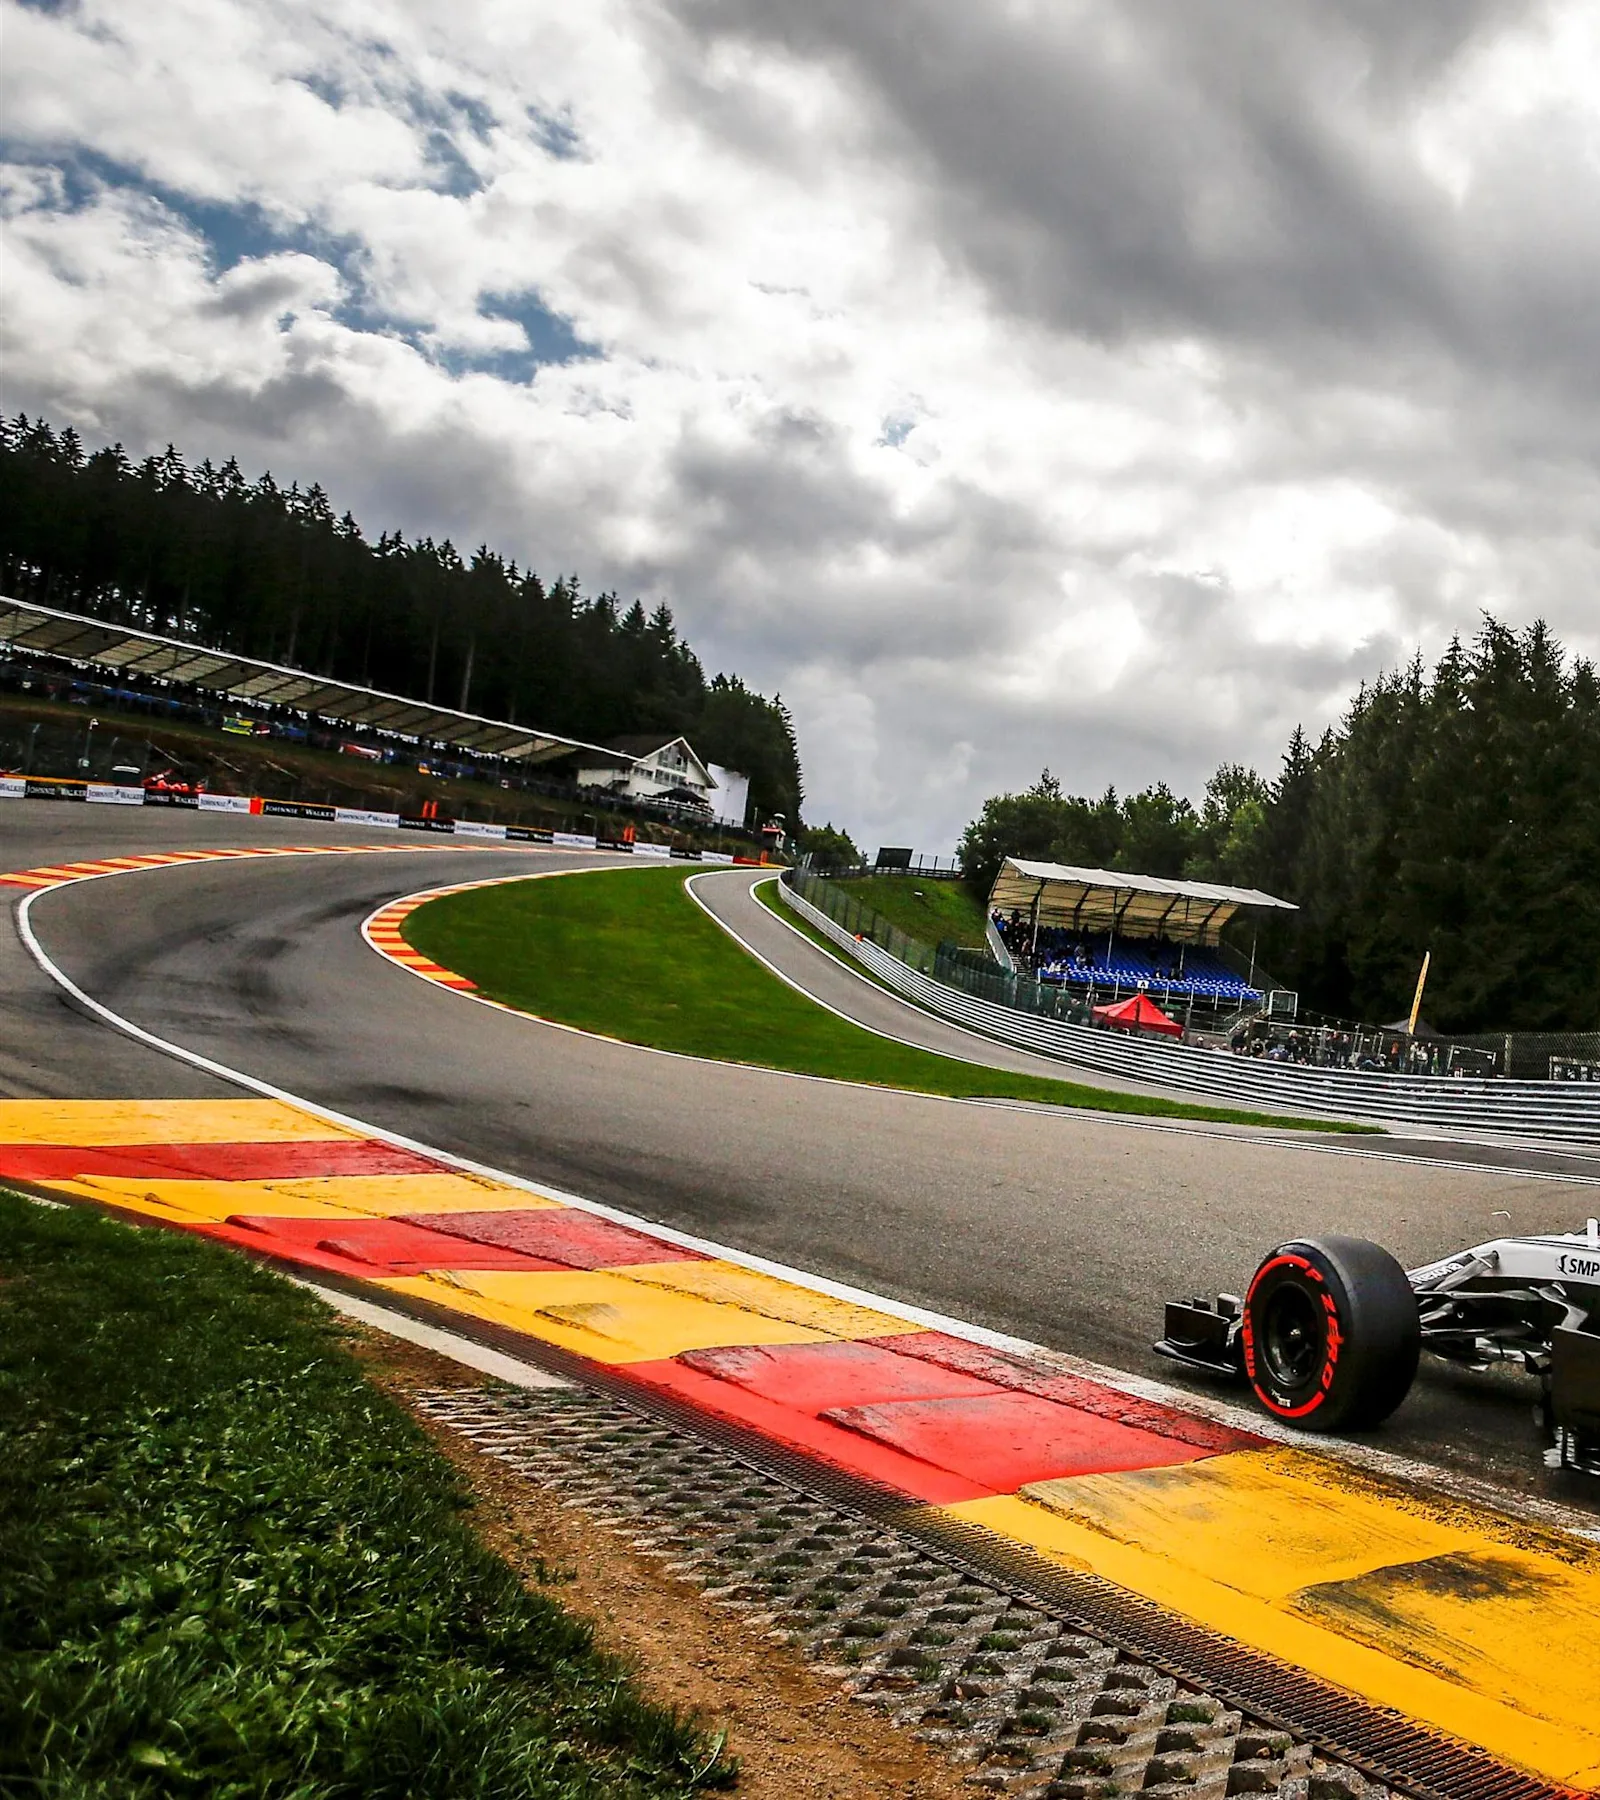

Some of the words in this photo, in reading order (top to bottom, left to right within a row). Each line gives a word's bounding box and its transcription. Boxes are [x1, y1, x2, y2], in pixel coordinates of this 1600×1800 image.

[264, 804, 298, 815] JOHNNIE
[305, 808, 334, 818] WALKER
[1568, 1258, 1600, 1277] SMP
